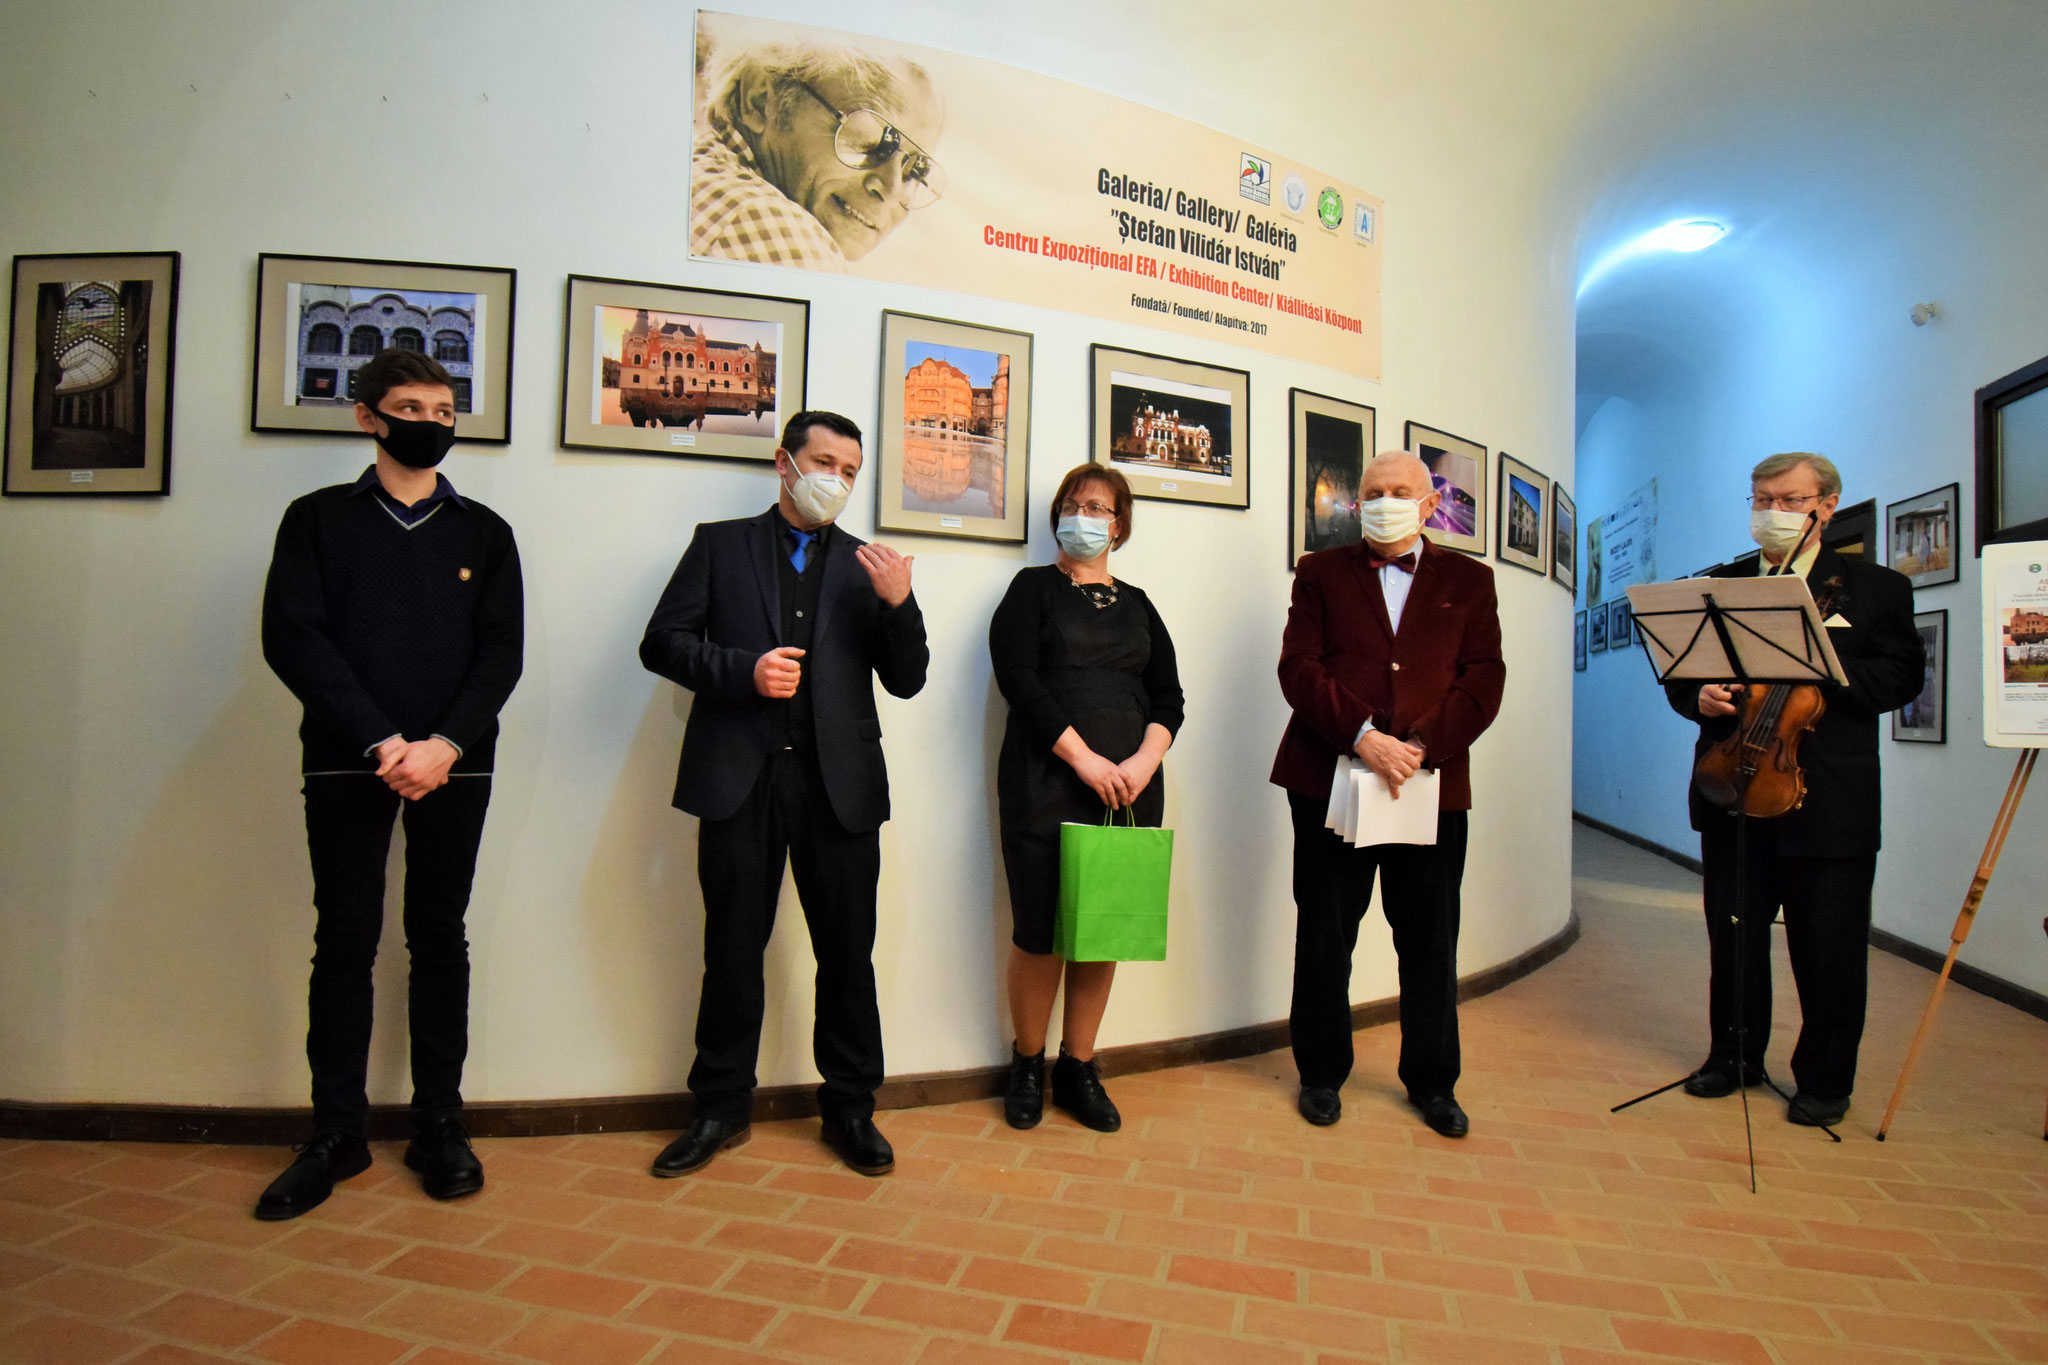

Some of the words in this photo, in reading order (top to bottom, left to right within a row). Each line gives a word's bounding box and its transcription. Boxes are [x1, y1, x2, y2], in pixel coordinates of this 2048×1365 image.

[1097, 168, 1172, 212] Galeria/
[1176, 190, 1241, 233] Gallery/
[1246, 214, 1297, 253] Galéria
[1180, 227, 1231, 266] Vilidár
[984, 225, 1038, 254] Centru
[1042, 236, 1133, 273] Expozițional
[1136, 255, 1158, 279] EFA
[1160, 261, 1167, 281] /
[1169, 264, 1229, 297] Exhibition
[1232, 281, 1274, 309] Center/
[1325, 307, 1363, 334] Központ
[1173, 302, 1213, 323] Founded/
[1250, 321, 1268, 336] 2017
